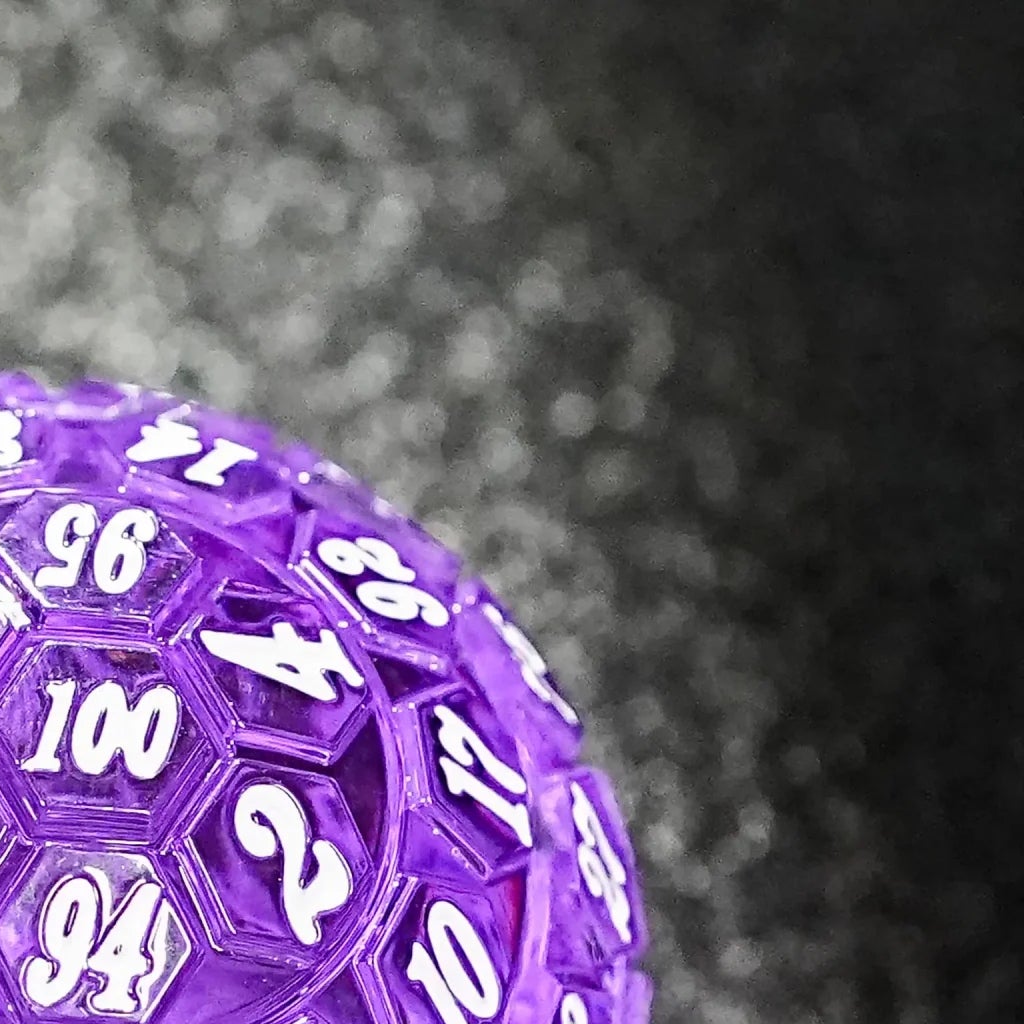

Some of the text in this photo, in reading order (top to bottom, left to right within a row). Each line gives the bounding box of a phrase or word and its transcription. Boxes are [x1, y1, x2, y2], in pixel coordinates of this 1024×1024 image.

[126, 417, 257, 486] 14
[35, 504, 158, 594] 95
[317, 537, 449, 627] 92
[201, 622, 364, 701] 4
[21, 680, 179, 779] 100
[234, 783, 353, 944] 2
[23, 874, 161, 1012] 94
